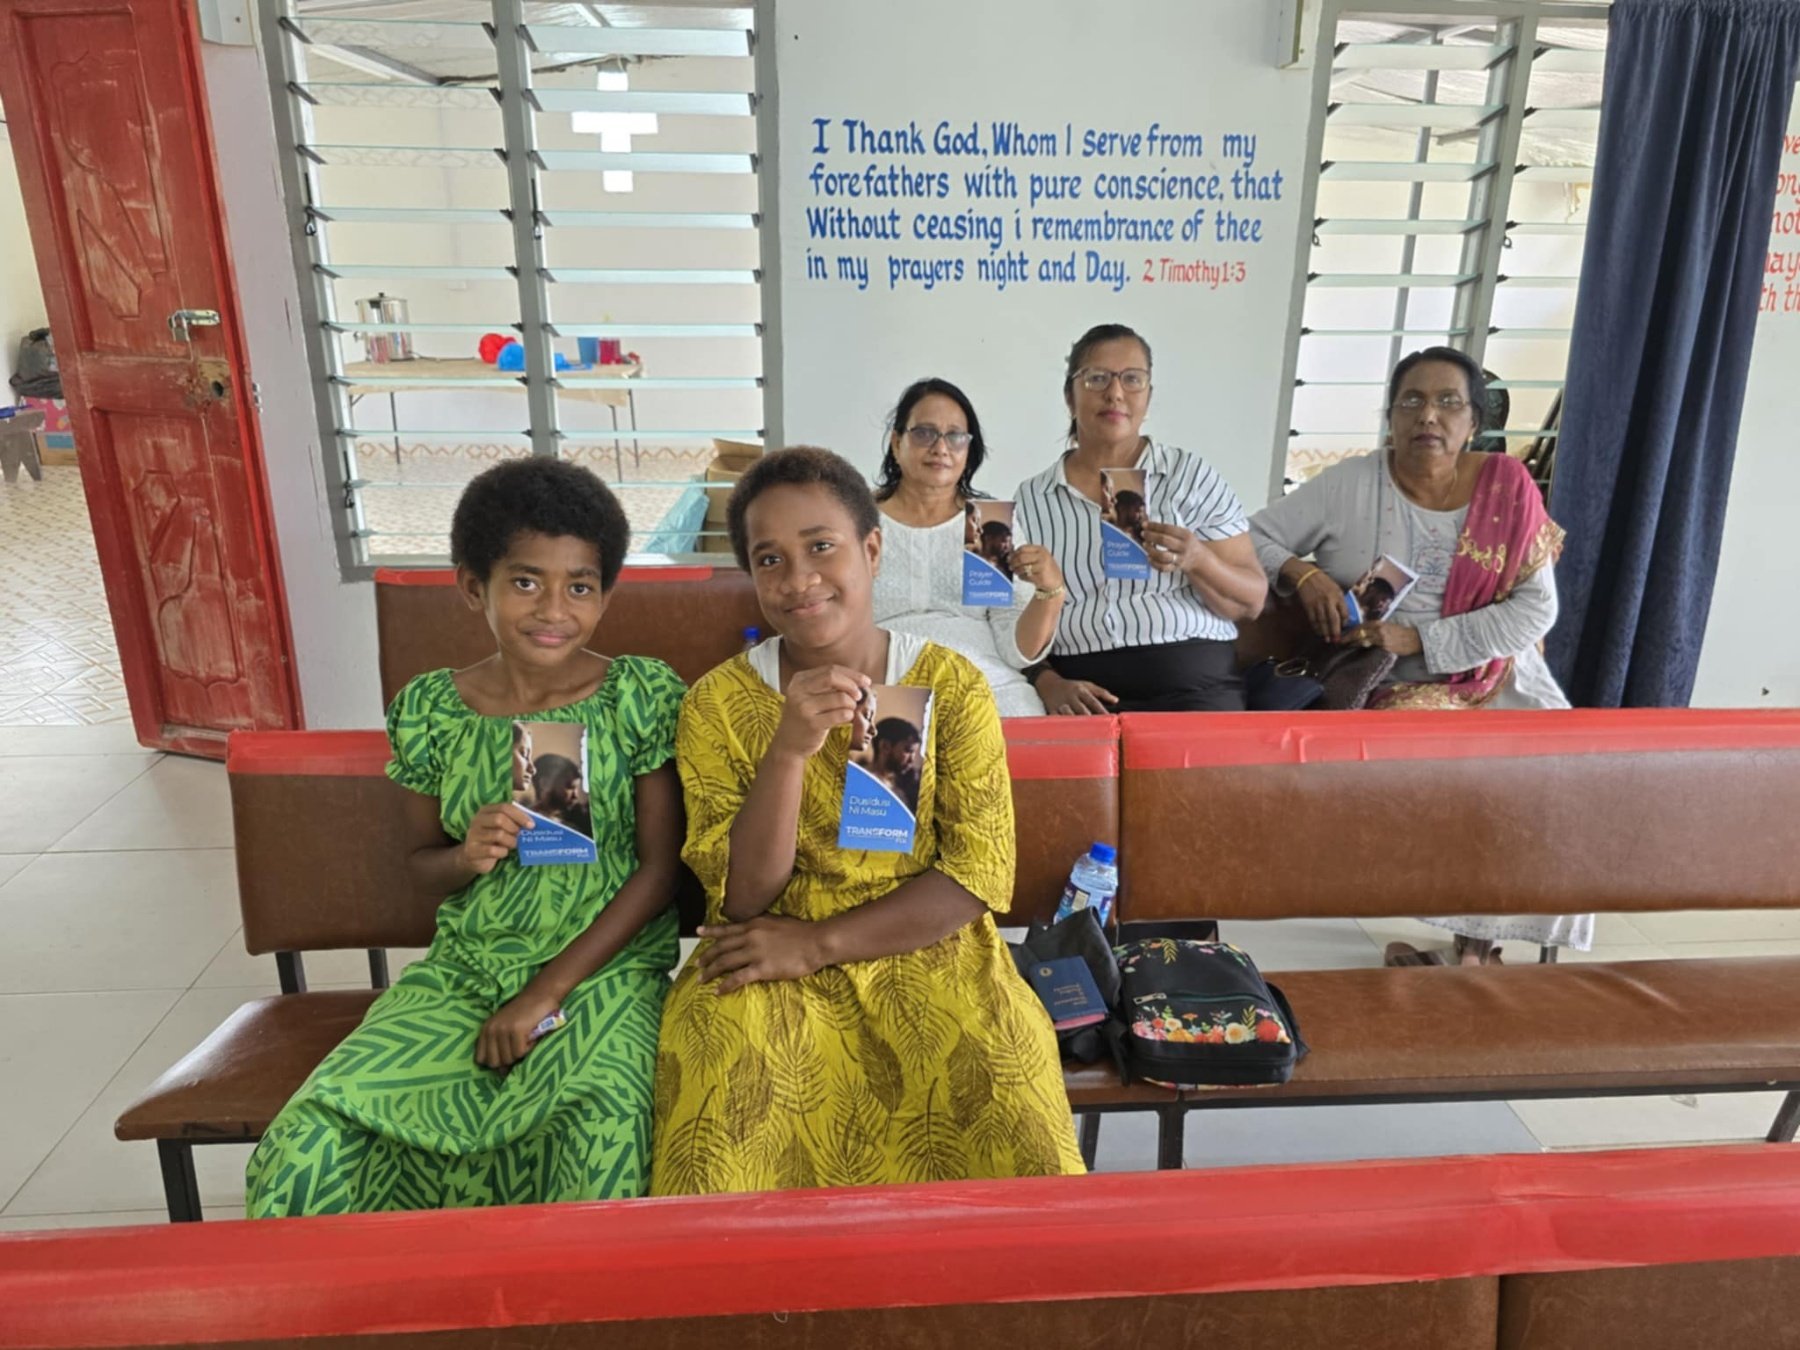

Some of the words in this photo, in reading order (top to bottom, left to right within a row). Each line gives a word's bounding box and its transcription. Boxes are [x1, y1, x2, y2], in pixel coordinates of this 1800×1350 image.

[813, 119, 831, 155] I
[842, 120, 926, 156] Thank
[991, 123, 1058, 156] Whom
[1081, 128, 1142, 158] serve
[1146, 123, 1203, 157] from
[1223, 134, 1256, 168] my
[809, 163, 950, 198] forefathers
[964, 165, 1018, 200] with
[1029, 174, 1082, 208] pure
[1230, 169, 1283, 200] that
[806, 207, 901, 241] Without
[913, 208, 1004, 249] ceasing
[1015, 209, 1022, 241] i
[1031, 209, 1175, 242] remembrance
[1182, 208, 1204, 241] of
[1215, 210, 1263, 243] thee
[806, 249, 828, 280] in
[837, 255, 869, 290] my
[888, 256, 965, 292] prayers
[977, 251, 1029, 291] night
[1038, 253, 1077, 283] and
[1085, 251, 1131, 292] Day.
[1143, 259, 1155, 283] 2
[846, 826, 909, 838] TRANSFORM
